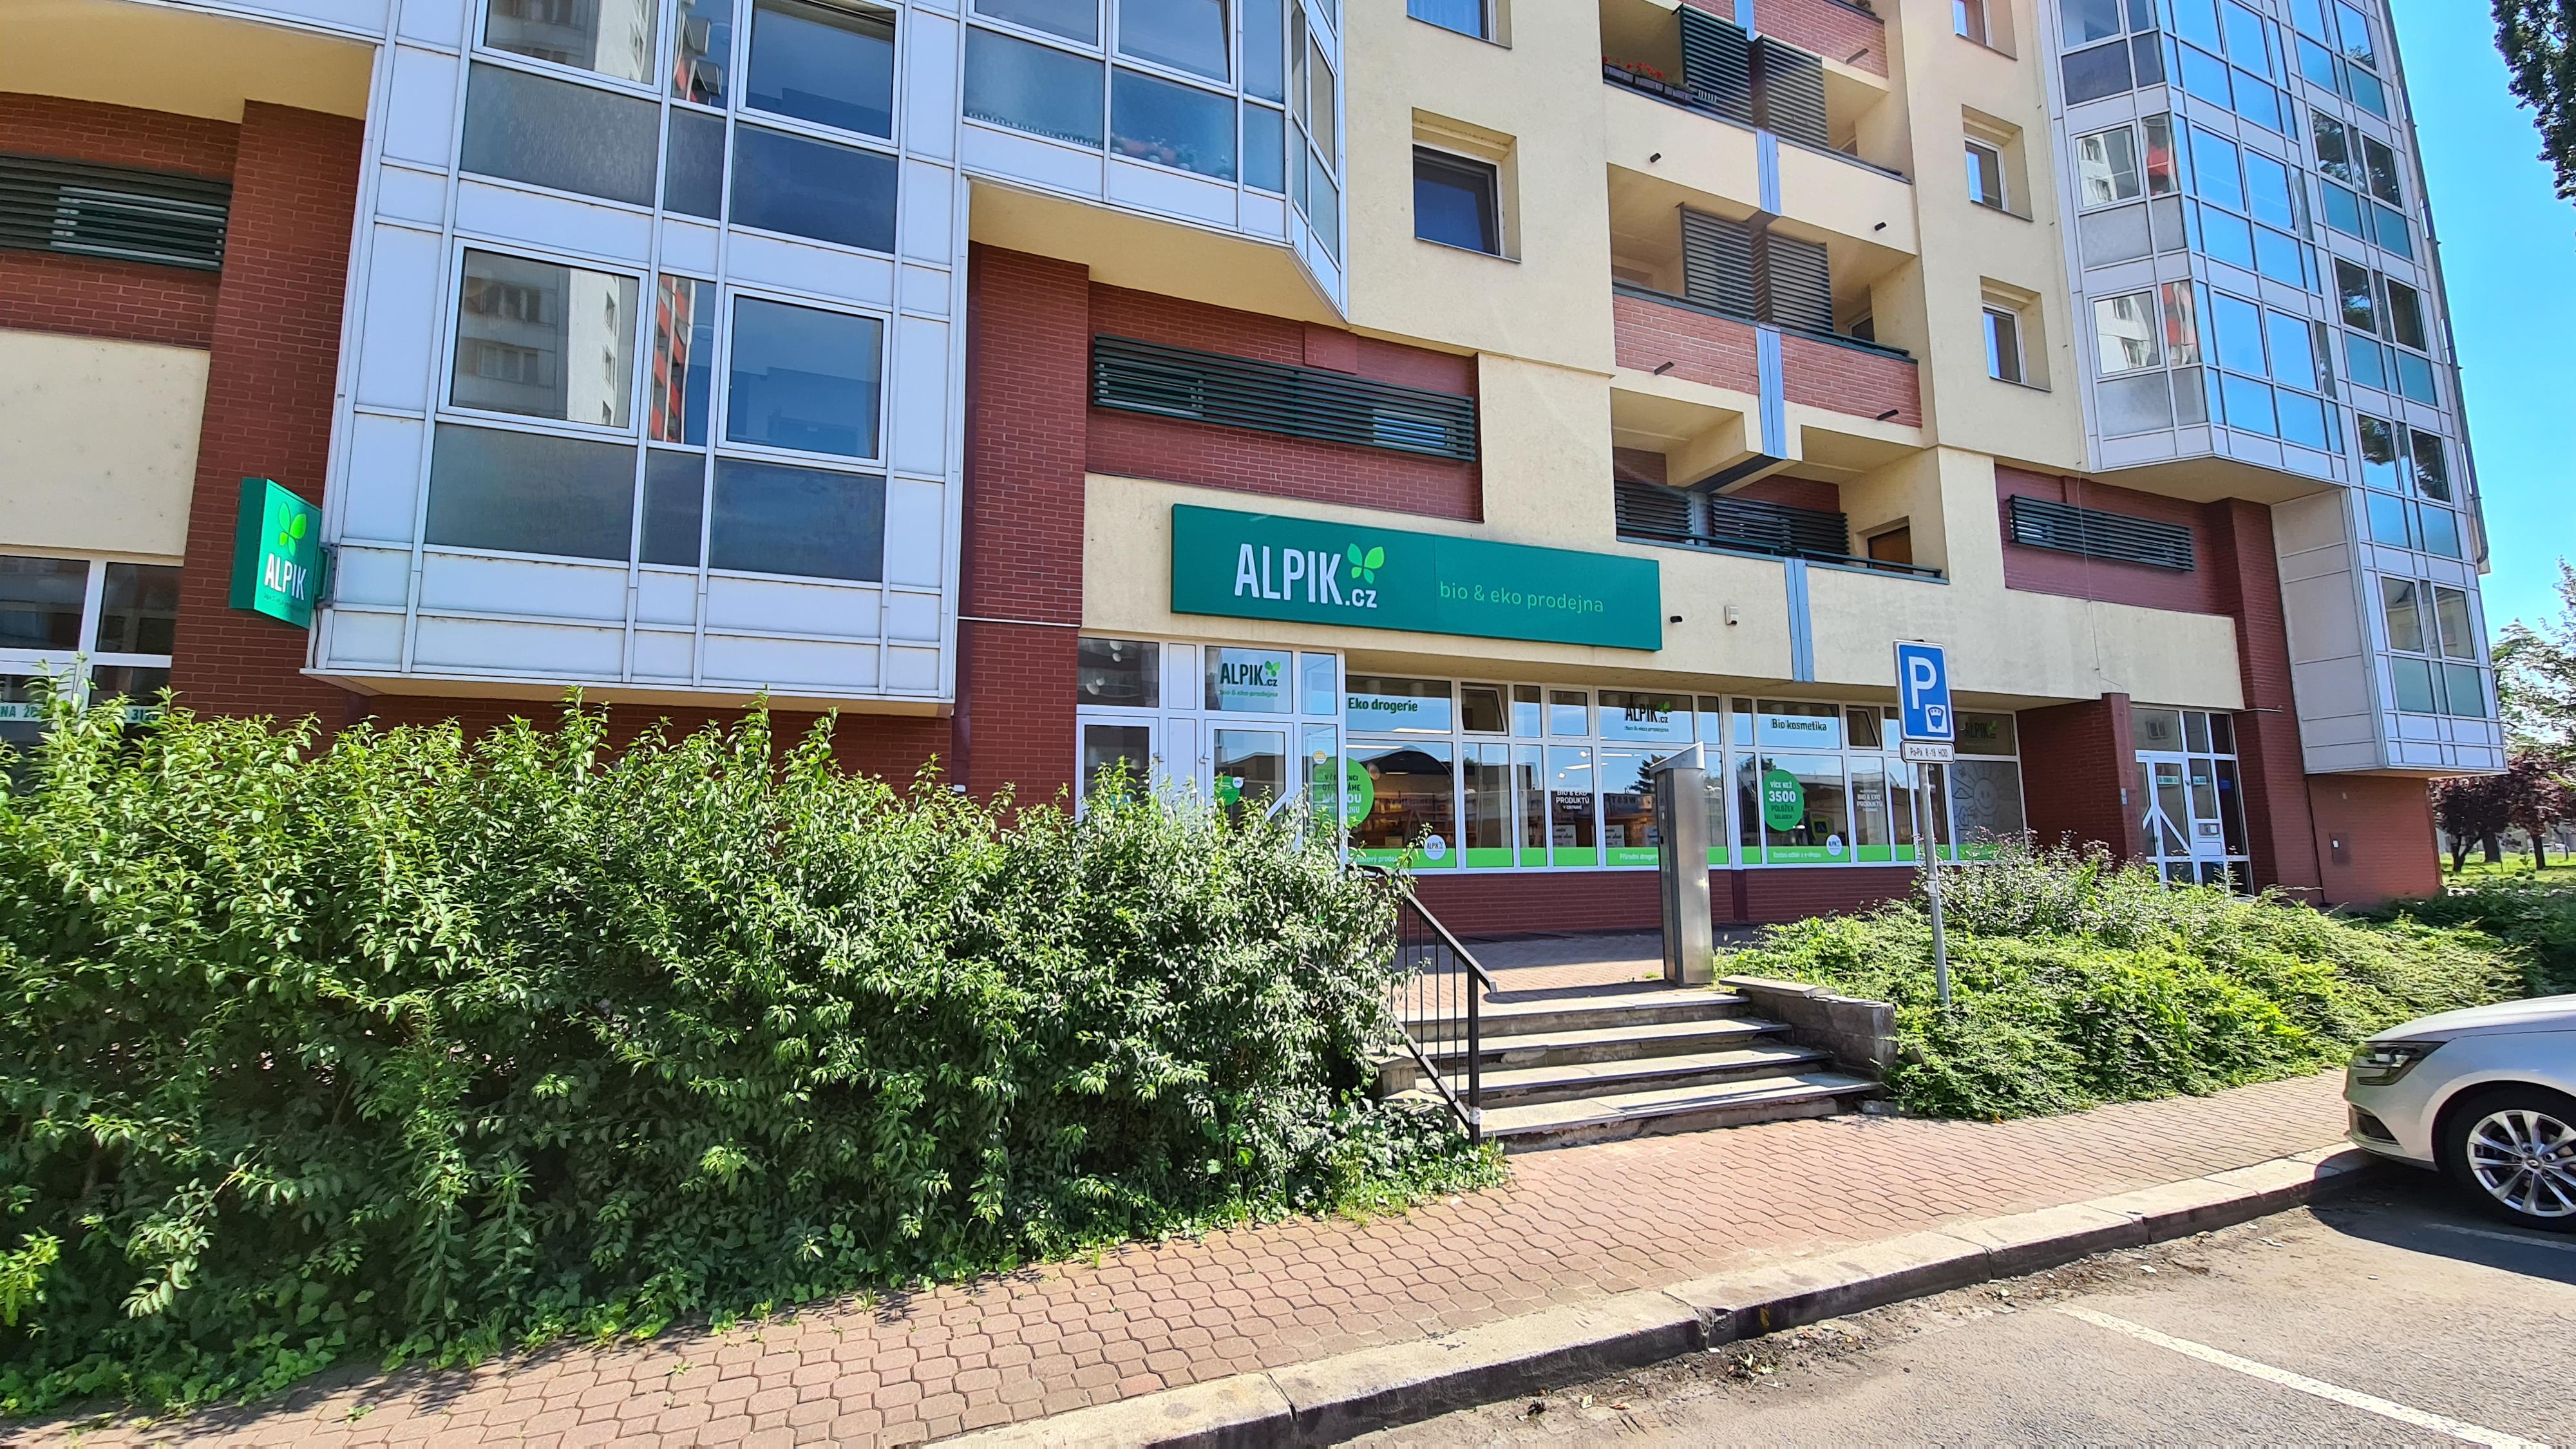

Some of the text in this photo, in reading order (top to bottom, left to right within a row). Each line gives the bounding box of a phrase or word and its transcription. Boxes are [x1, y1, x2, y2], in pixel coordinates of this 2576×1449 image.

[264, 553, 307, 601] ALPIK
[1234, 543, 1378, 608] ALPIK.cz
[1440, 581, 1604, 614] bio & eko prodejna
[1908, 656, 1938, 710] P
[1348, 697, 1418, 714] Eko drogerie
[1771, 718, 1827, 731] Bio kosmetika
[1555, 796, 1590, 804] PRODUKTŮ
[1768, 790, 1797, 803] 3500
